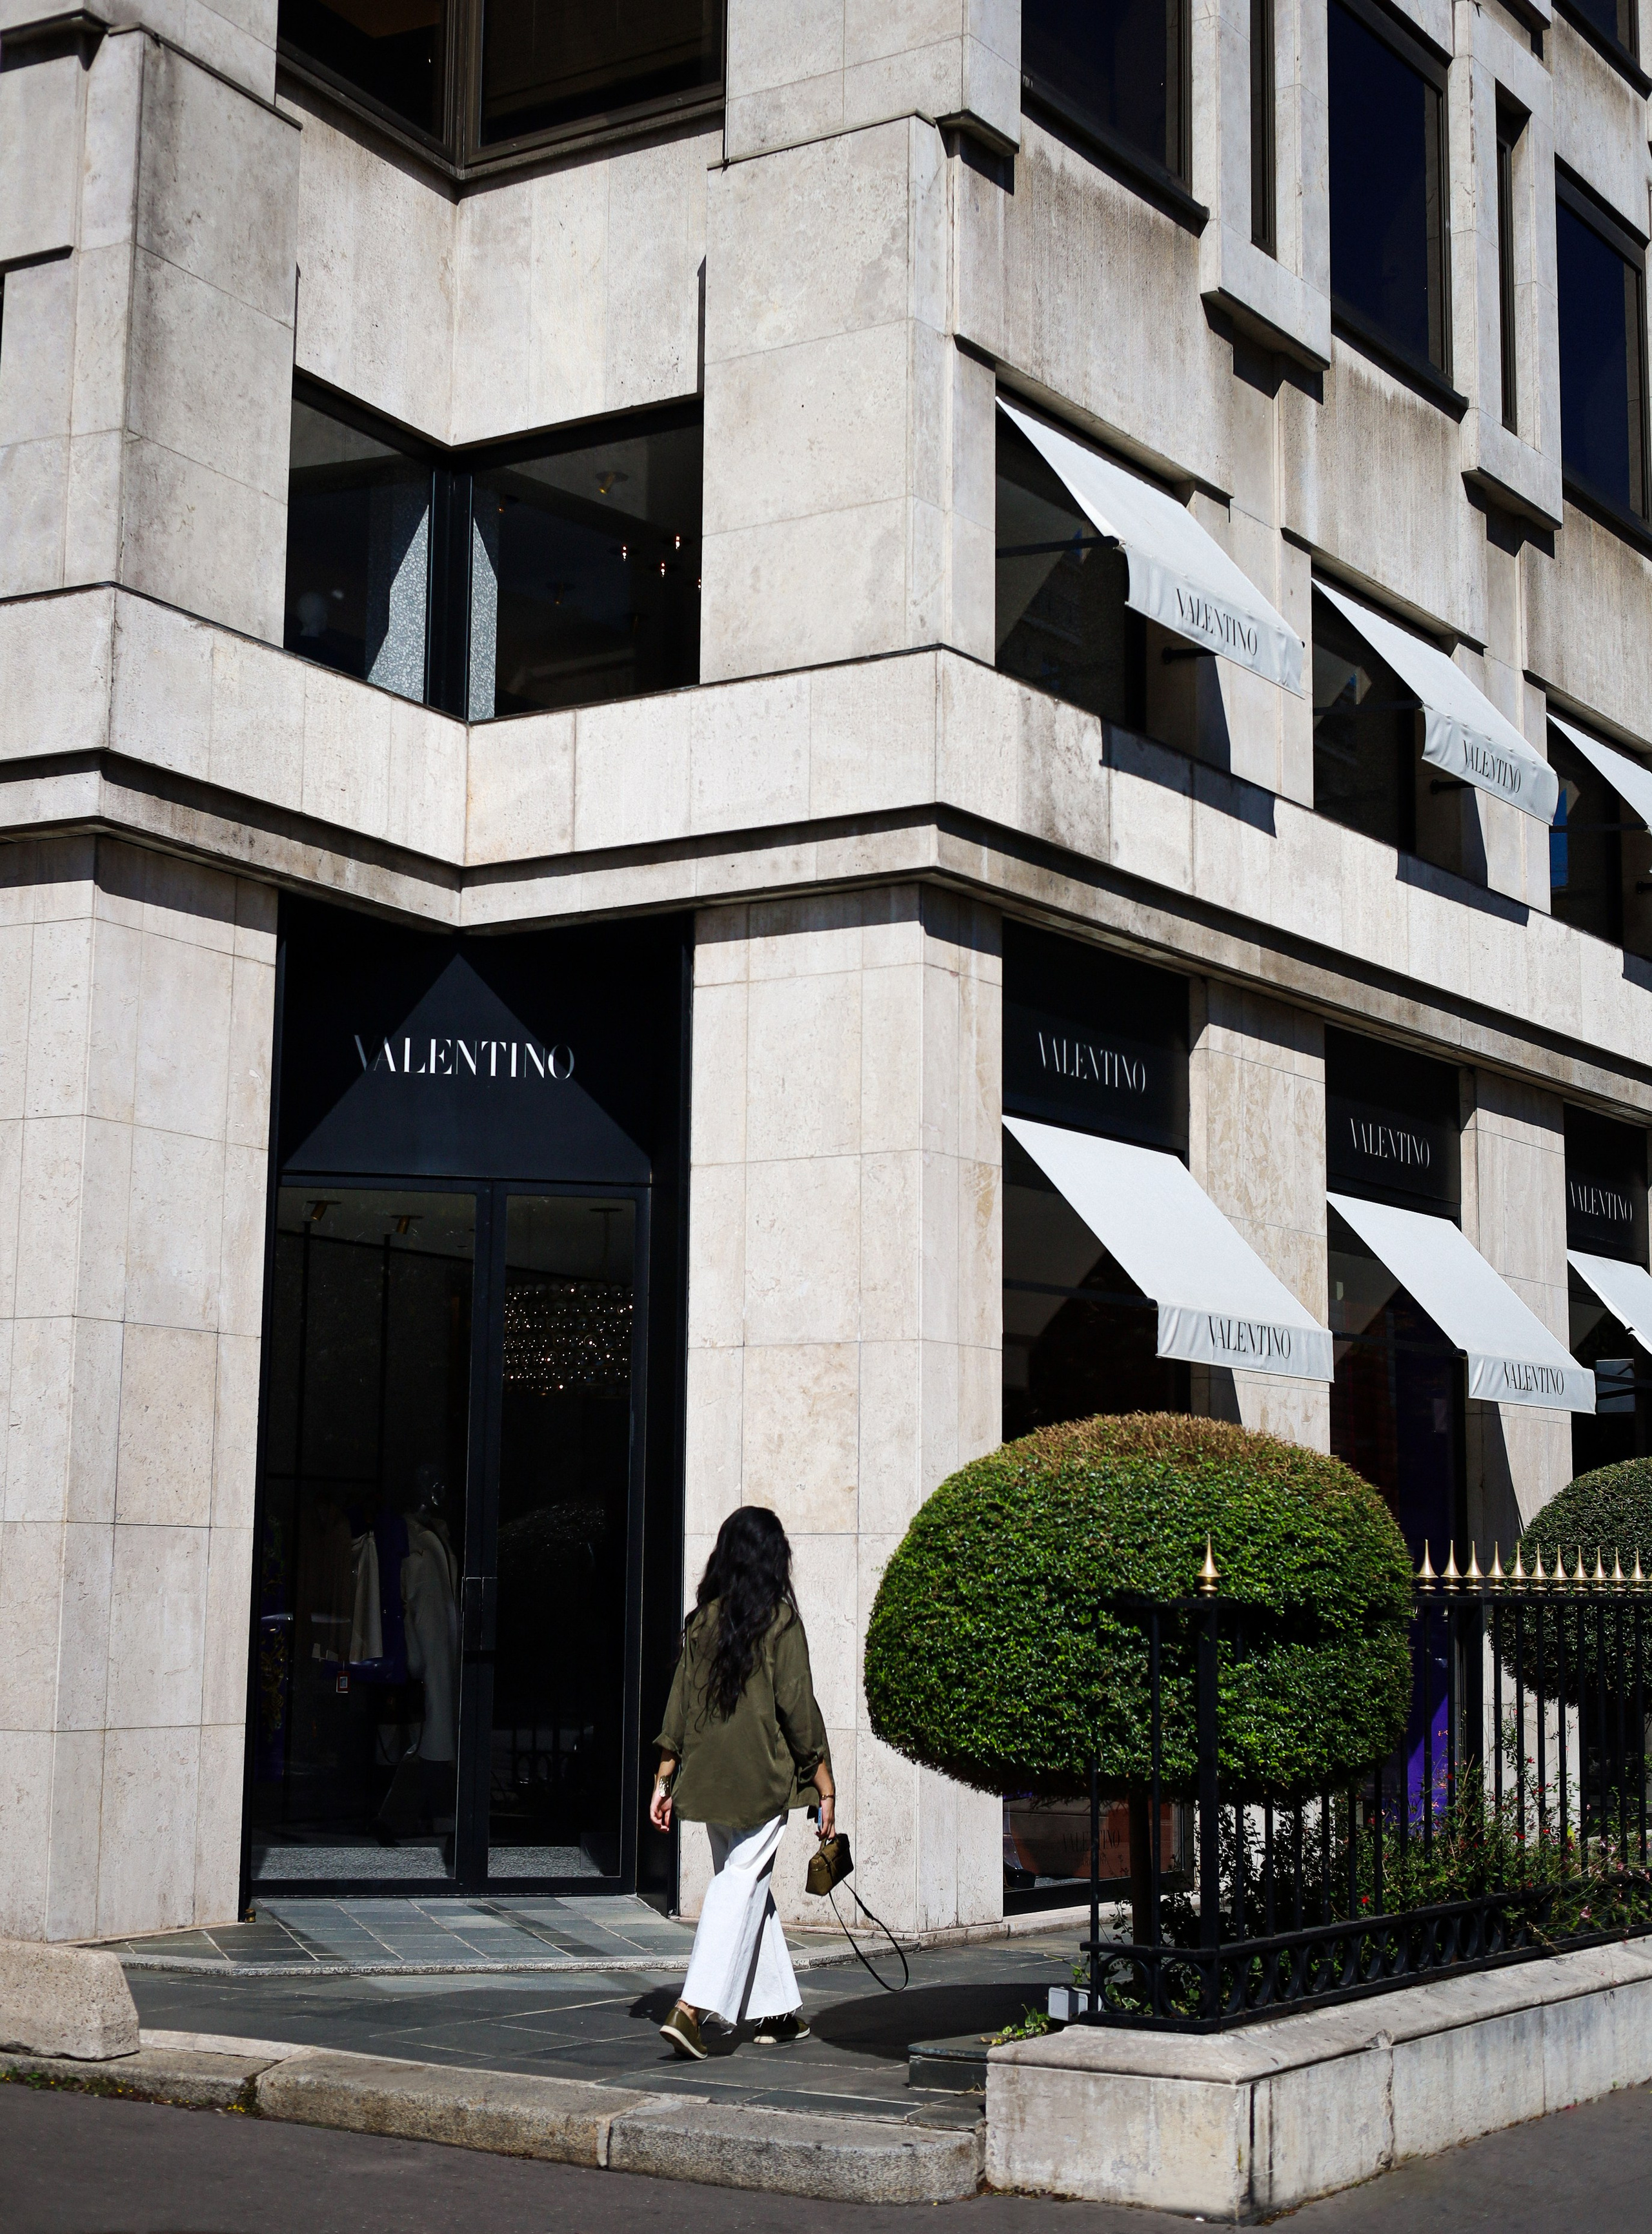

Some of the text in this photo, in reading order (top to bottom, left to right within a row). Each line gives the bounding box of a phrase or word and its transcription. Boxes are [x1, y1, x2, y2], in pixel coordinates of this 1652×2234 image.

[1175, 588, 1258, 656] VALENTINO
[1462, 739, 1521, 794] VALENTINO
[354, 1035, 575, 1080] VALENTINO
[1038, 1031, 1146, 1093] VALENTINO
[1349, 1117, 1430, 1169] VALENTINO
[1569, 1181, 1633, 1223] VALENTINO
[1207, 1315, 1291, 1359] VALENTINO
[1503, 1361, 1564, 1396] VALENTINO
